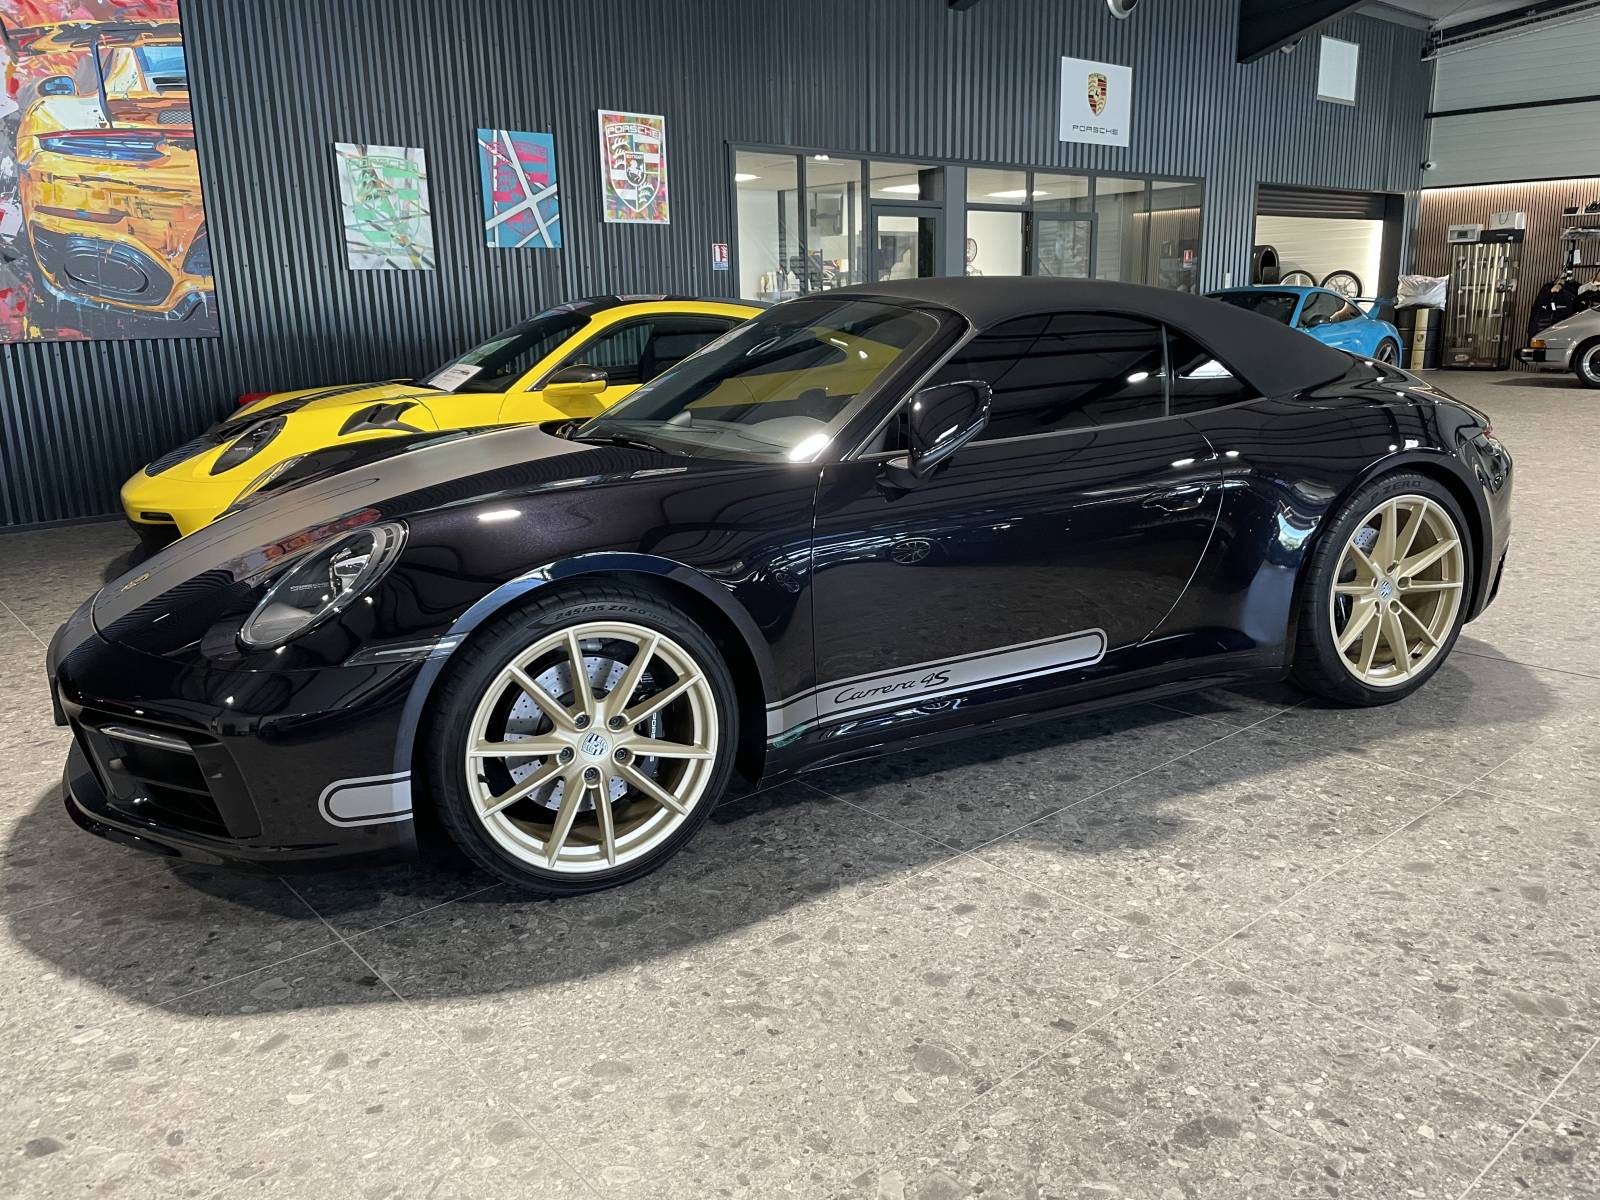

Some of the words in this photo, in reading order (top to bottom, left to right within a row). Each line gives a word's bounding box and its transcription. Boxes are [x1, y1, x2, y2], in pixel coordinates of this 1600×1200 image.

[606, 125, 660, 139] PORSCHE
[1072, 124, 1118, 136] PORSCHE
[608, 604, 646, 615] ZR20
[834, 681, 916, 704] Carrera
[920, 669, 951, 688] 4S
